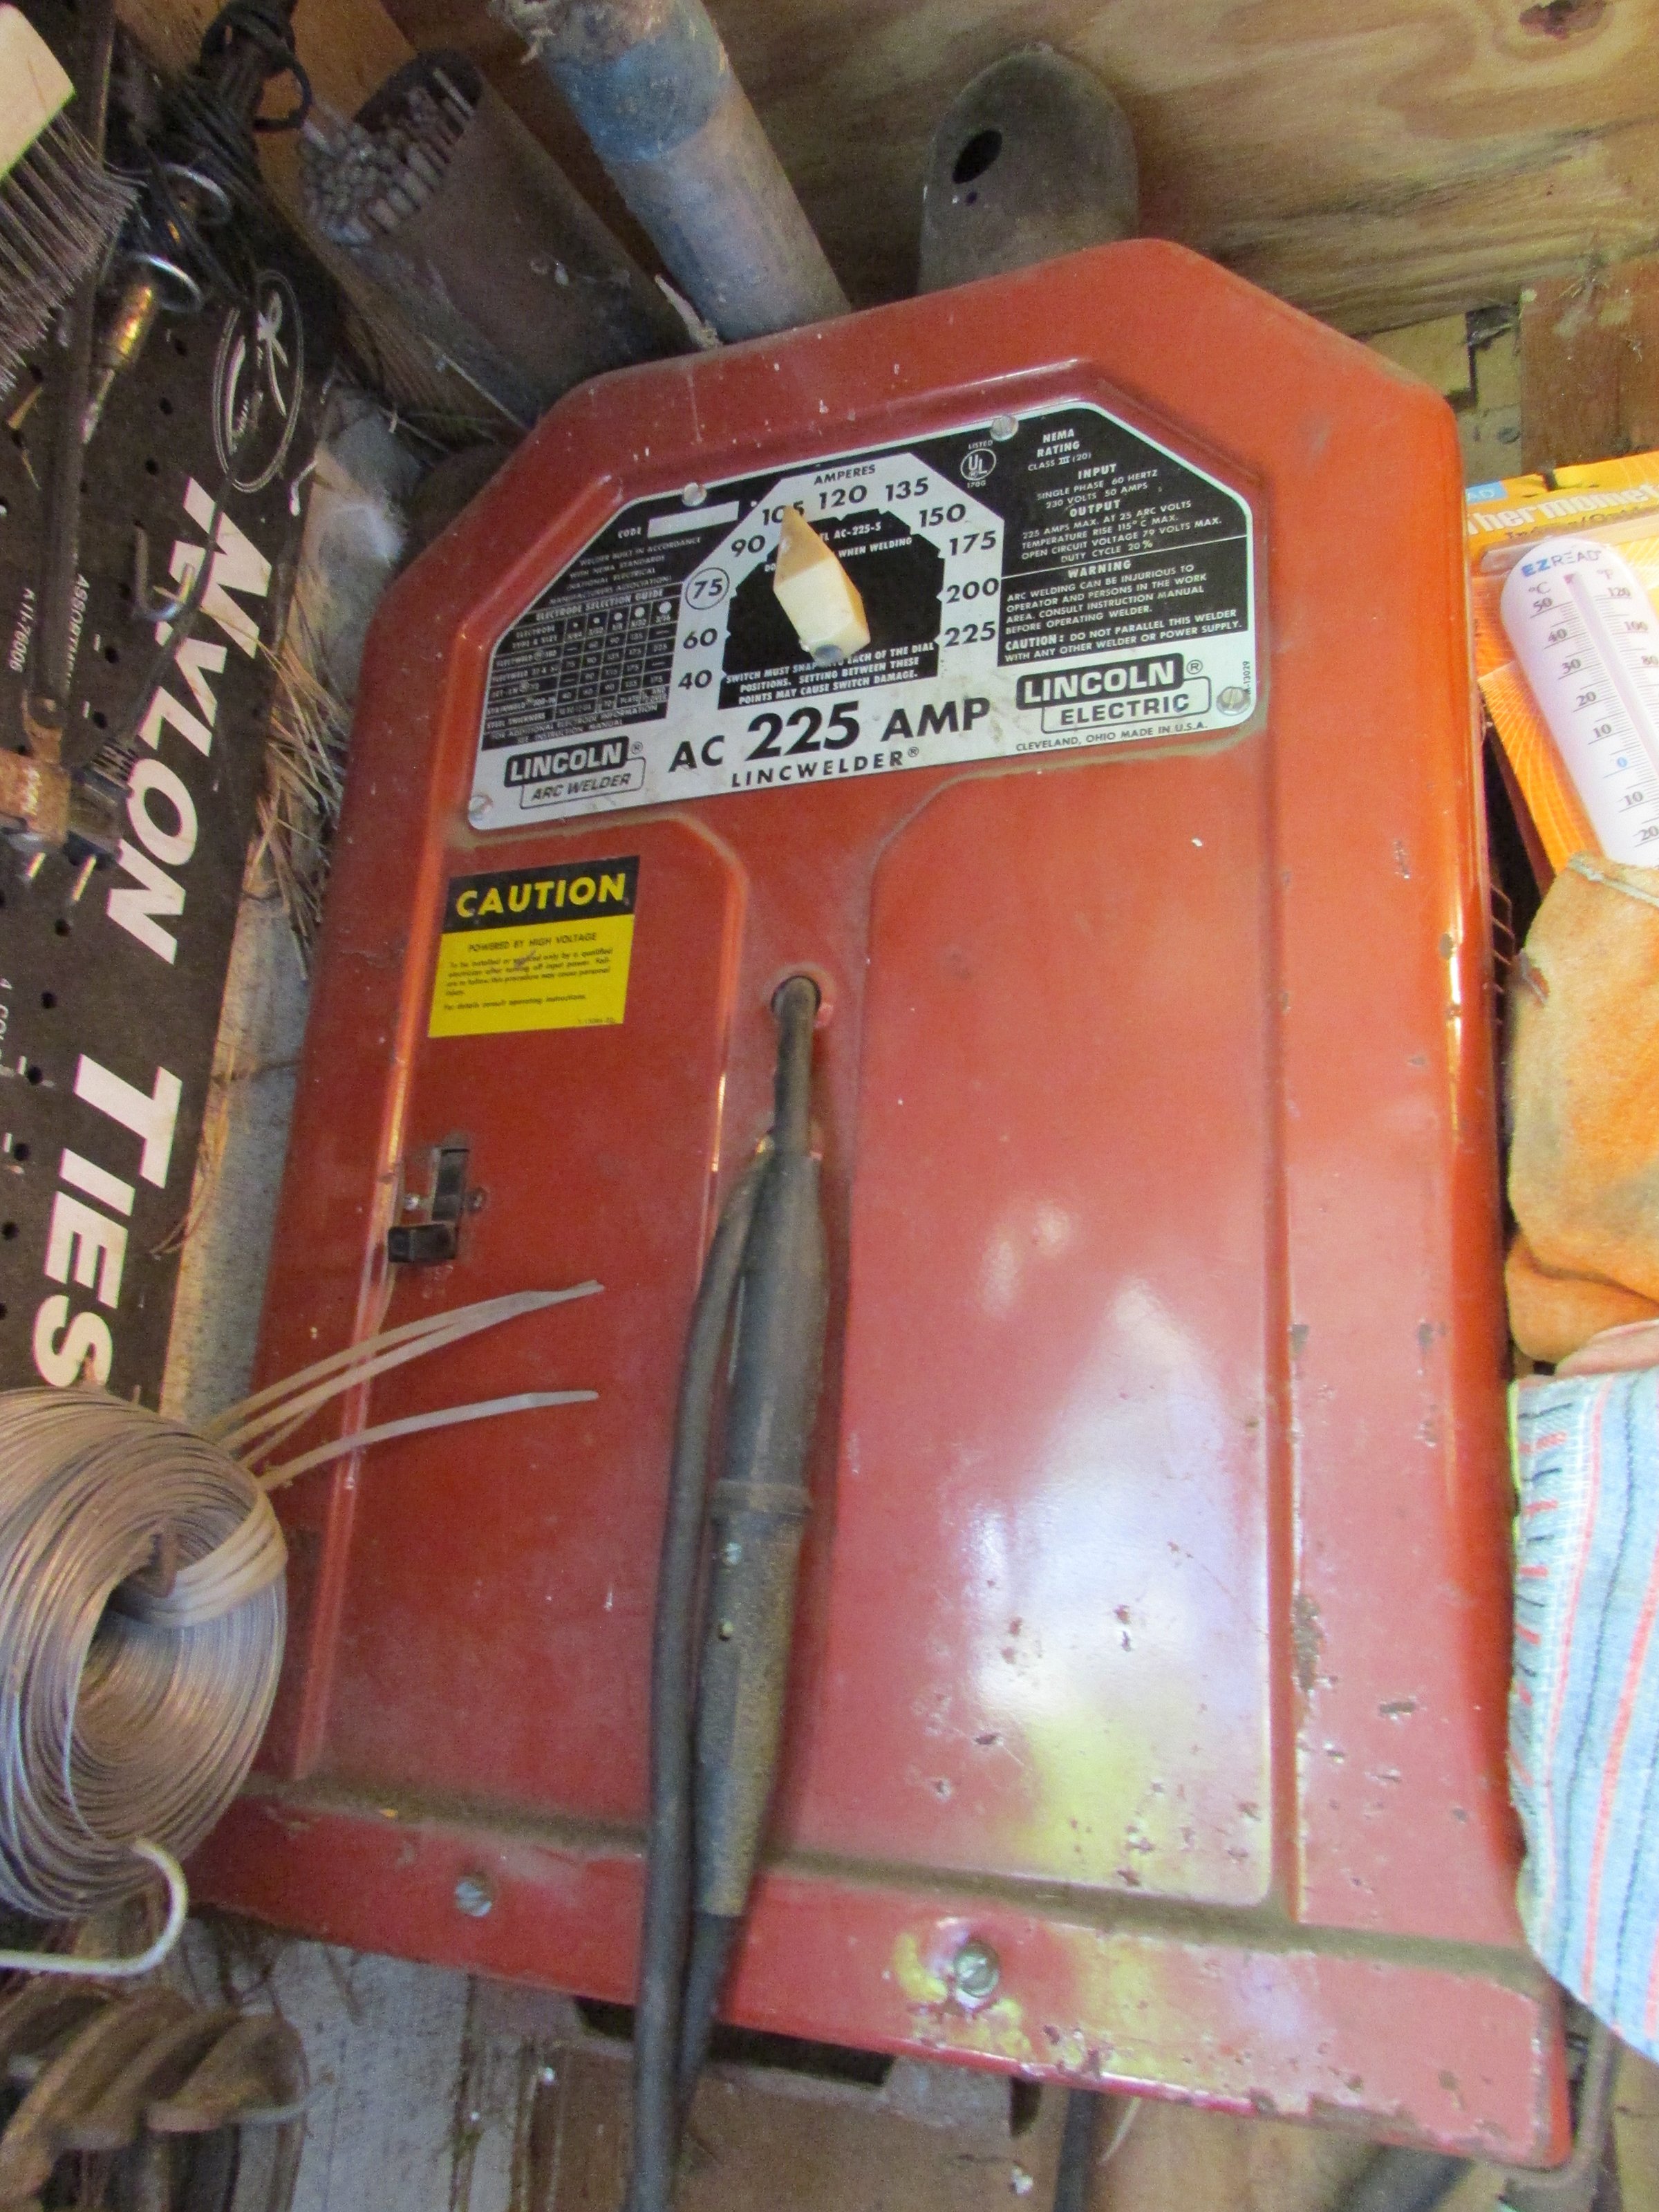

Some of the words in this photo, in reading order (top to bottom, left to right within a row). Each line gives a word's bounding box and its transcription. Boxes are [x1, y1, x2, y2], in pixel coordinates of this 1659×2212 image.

[1043, 429, 1074, 443] NEMA
[1028, 460, 1055, 471] CLASS
[1073, 452, 1091, 463] (20)
[1037, 441, 1080, 458] RATING
[814, 465, 876, 485] AMPERES
[1078, 463, 1116, 479] INPUT
[819, 485, 868, 509] 120
[885, 477, 929, 501] 135
[1038, 487, 1070, 500] SINGLE
[1074, 481, 1104, 493] PHASE
[1112, 476, 1124, 485] 60
[1127, 470, 1158, 482] HERTZ
[1047, 500, 1063, 508] 230
[1067, 493, 1096, 505] VOLTS
[1105, 489, 1116, 497] 50
[1121, 483, 1147, 494] AMPS
[919, 503, 966, 527] 150
[1044, 524, 1070, 535] AMPS
[1074, 519, 1099, 529] MAX.
[1136, 507, 1156, 518] ARC
[1161, 501, 1191, 513] VOLTS
[1070, 500, 1121, 518] OUTPUT
[949, 530, 996, 556] 175
[1022, 532, 1087, 550] TEMPERATURE
[1093, 526, 1112, 536] RISE
[1152, 514, 1178, 525] MAX.
[1022, 550, 1048, 560] OPEN
[1051, 542, 1087, 554] CIRCUIT
[1091, 532, 1138, 546] VOLTAGE
[1160, 522, 1190, 534] VOLTS
[1194, 518, 1221, 528] MAX.
[648, 537, 701, 552] ACCORDANCE
[731, 535, 766, 557] 90
[870, 537, 912, 552] WELDING
[1061, 552, 1085, 563] DUTY
[1092, 547, 1121, 558] CYCLE
[1068, 560, 1132, 578] WARNING
[693, 578, 722, 599] 75
[946, 578, 1000, 603] 200
[1006, 598, 1058, 612] OPERATOR
[1062, 593, 1084, 603] AND
[1088, 585, 1132, 599] PERSONS
[1137, 583, 1147, 591] IN
[1152, 579, 1170, 588] THE
[1175, 573, 1207, 585] WORK
[1007, 592, 1026, 601] ARC
[1031, 583, 1075, 598] WELDING
[1080, 579, 1101, 590] CAN
[1106, 577, 1117, 585] BE
[1121, 568, 1176, 582] INJURIOUS
[1181, 564, 1194, 573] TO
[1609, 587, 1631, 597] 120
[586, 595, 631, 610] SELECTION
[635, 589, 663, 601] GUIDE
[1006, 614, 1034, 623] AREA.
[1039, 604, 1083, 618] CONSULT
[1087, 593, 1153, 610] INSTRUCTION
[1158, 585, 1204, 600] MANUAL
[1533, 597, 1553, 614] 50
[1006, 623, 1041, 635] BEFORE
[1047, 612, 1103, 628] OPERATING
[1109, 606, 1152, 618] WELDER.
[1070, 632, 1085, 641] DO
[1089, 628, 1110, 639] NOT
[1115, 620, 1165, 635] PARALLEL
[1169, 617, 1190, 626] THIS
[1194, 609, 1236, 623] WELDER
[1624, 621, 1648, 631] 100
[683, 628, 718, 649] 60
[944, 621, 996, 647] 225
[1005, 652, 1030, 662] WITH
[1034, 648, 1055, 658] ANY
[1060, 642, 1092, 655] OTHER
[1096, 637, 1136, 649] WELDER
[1141, 633, 1156, 642] OR
[1160, 628, 1198, 639] POWER
[1201, 621, 1241, 633] SUPPLY.
[1548, 629, 1567, 643] 40
[875, 650, 886, 659] OF
[890, 646, 908, 657] THE
[912, 643, 934, 653] DIAL
[727, 672, 760, 684] SWITCH
[764, 666, 789, 677] MUST
[799, 671, 837, 684] SETTING
[842, 663, 885, 676] BETWEEN
[890, 657, 919, 669] THESE
[1562, 659, 1582, 674] 30
[678, 670, 712, 689] 40
[739, 694, 772, 704] POINTS
[776, 688, 796, 698] MAY
[800, 684, 829, 695] CAUSE
[833, 678, 870, 691] SWITCH
[874, 671, 917, 684] DAMAGE.
[1024, 661, 1175, 704] LINCOLN
[1061, 693, 1189, 725] ELECTRIC
[1577, 691, 1597, 706] 20
[106, 477, 272, 965] NYLON
[1593, 724, 1612, 738] 10
[668, 735, 724, 772] AC
[744, 700, 860, 761] 225
[881, 697, 990, 742] AMP
[1016, 738, 1081, 751] CLEVELAND,
[1086, 732, 1116, 742] OHIO
[1121, 727, 1153, 738] MADE
[1176, 722, 1208, 732] U.S.A.
[511, 742, 622, 781] LINCOLN
[731, 751, 903, 788] LINCWELDER
[532, 785, 563, 801] ARC
[568, 774, 631, 794] WELDER
[1623, 791, 1644, 806] 10
[1640, 825, 1659, 841] 20
[456, 873, 626, 917] CAUTION
[529, 937, 552, 946] HIGH
[555, 932, 597, 944] VOLTAGE
[32, 1054, 182, 1387] TIES
